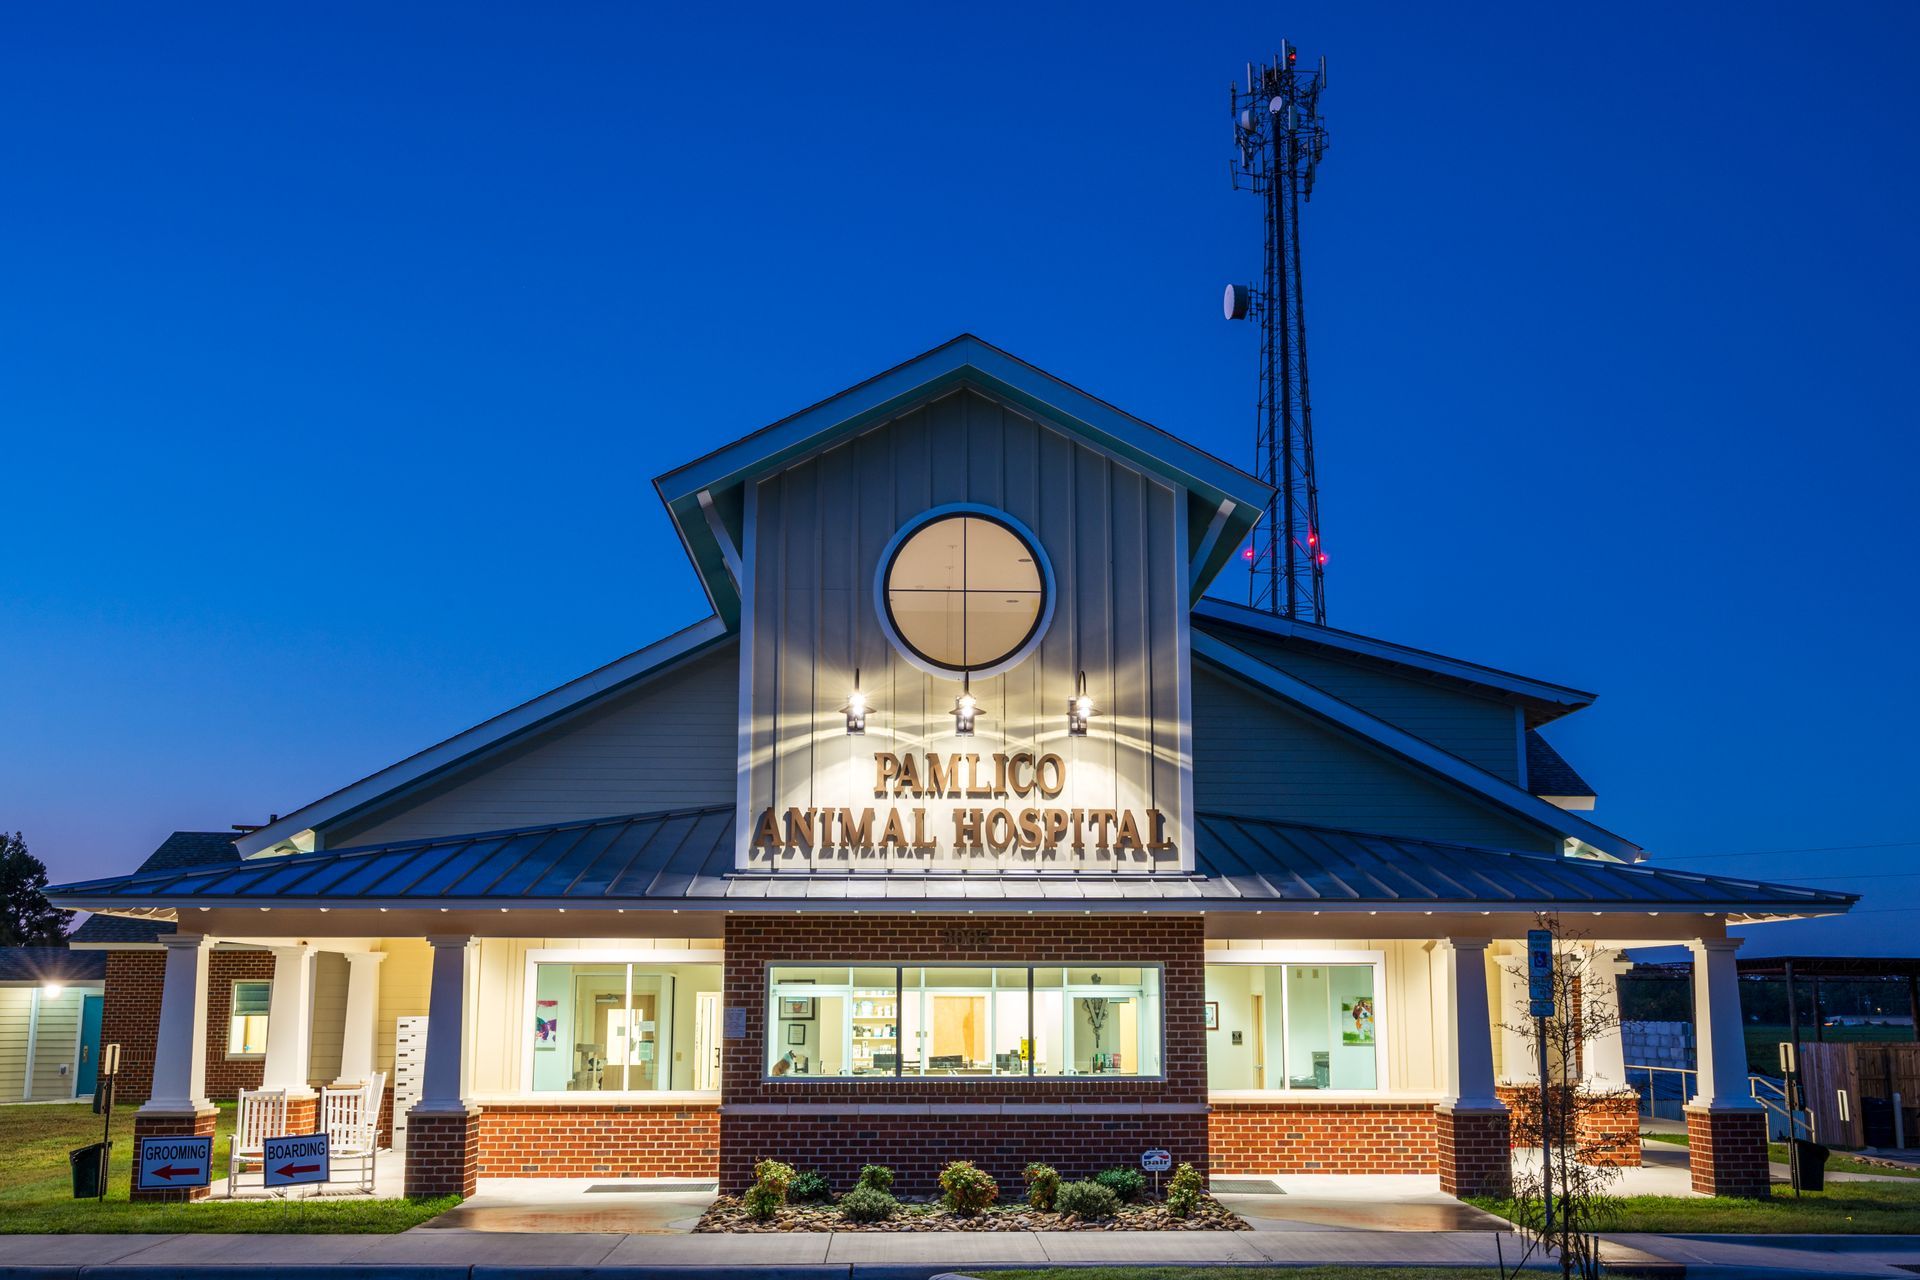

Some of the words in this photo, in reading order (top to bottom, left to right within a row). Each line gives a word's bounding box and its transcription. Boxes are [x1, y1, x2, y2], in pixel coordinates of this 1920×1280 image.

[874, 752, 1065, 795] PAMLICO
[753, 807, 937, 849] ANIMAL
[953, 808, 1172, 850] HOSPITAL
[145, 1145, 206, 1160] GROOMING
[268, 1142, 326, 1160] BOARDING
